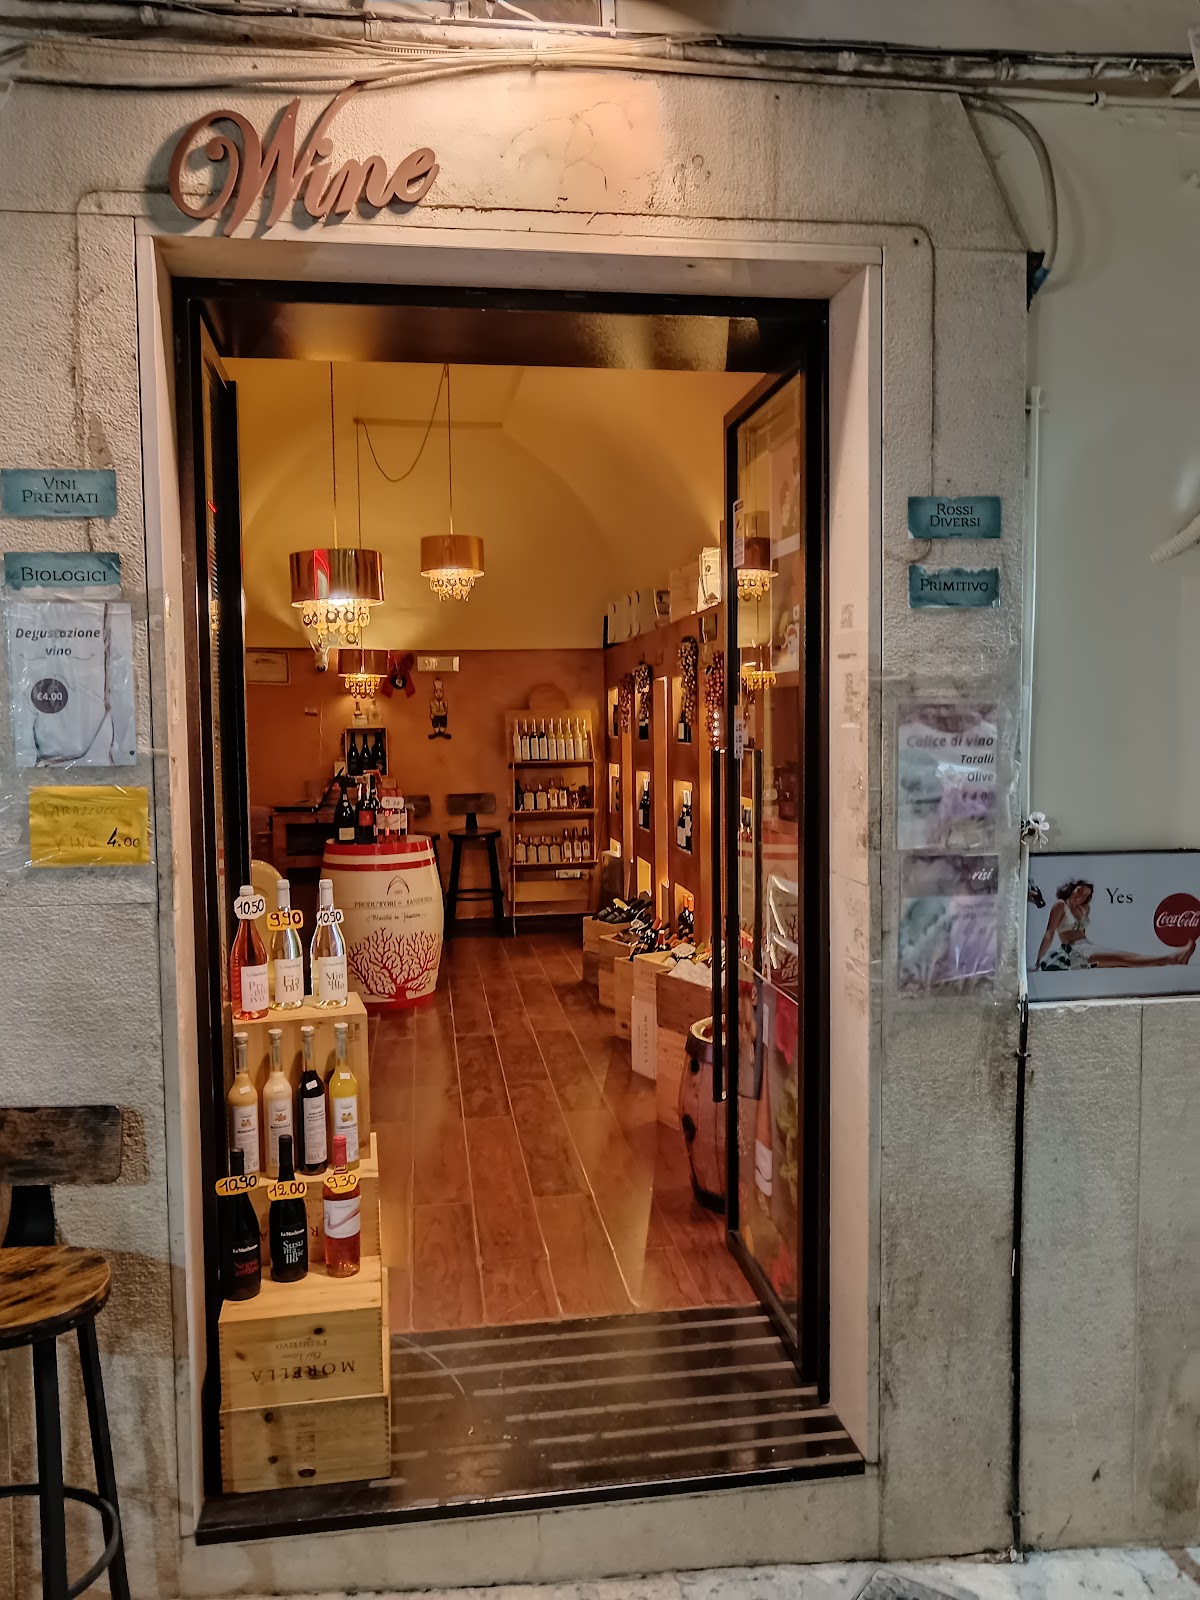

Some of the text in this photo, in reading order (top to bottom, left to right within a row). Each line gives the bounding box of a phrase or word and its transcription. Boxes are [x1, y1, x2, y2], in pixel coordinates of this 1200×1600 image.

[169, 82, 440, 237] Wine
[42, 477, 76, 490] Vini
[22, 489, 99, 503] Premiati
[937, 503, 973, 515] Rossi
[930, 515, 981, 527] Diversi
[20, 567, 106, 581] Biologici
[920, 579, 989, 591] Primitivo
[15, 628, 101, 641] Degustazione
[45, 645, 72, 656] vino
[907, 734, 994, 748] Calice di vino
[961, 754, 994, 764] Taralli
[967, 772, 994, 782] Olive
[106, 827, 140, 849] 4.00
[1105, 887, 1134, 904] Yes
[251, 1360, 355, 1382] MORELLA
